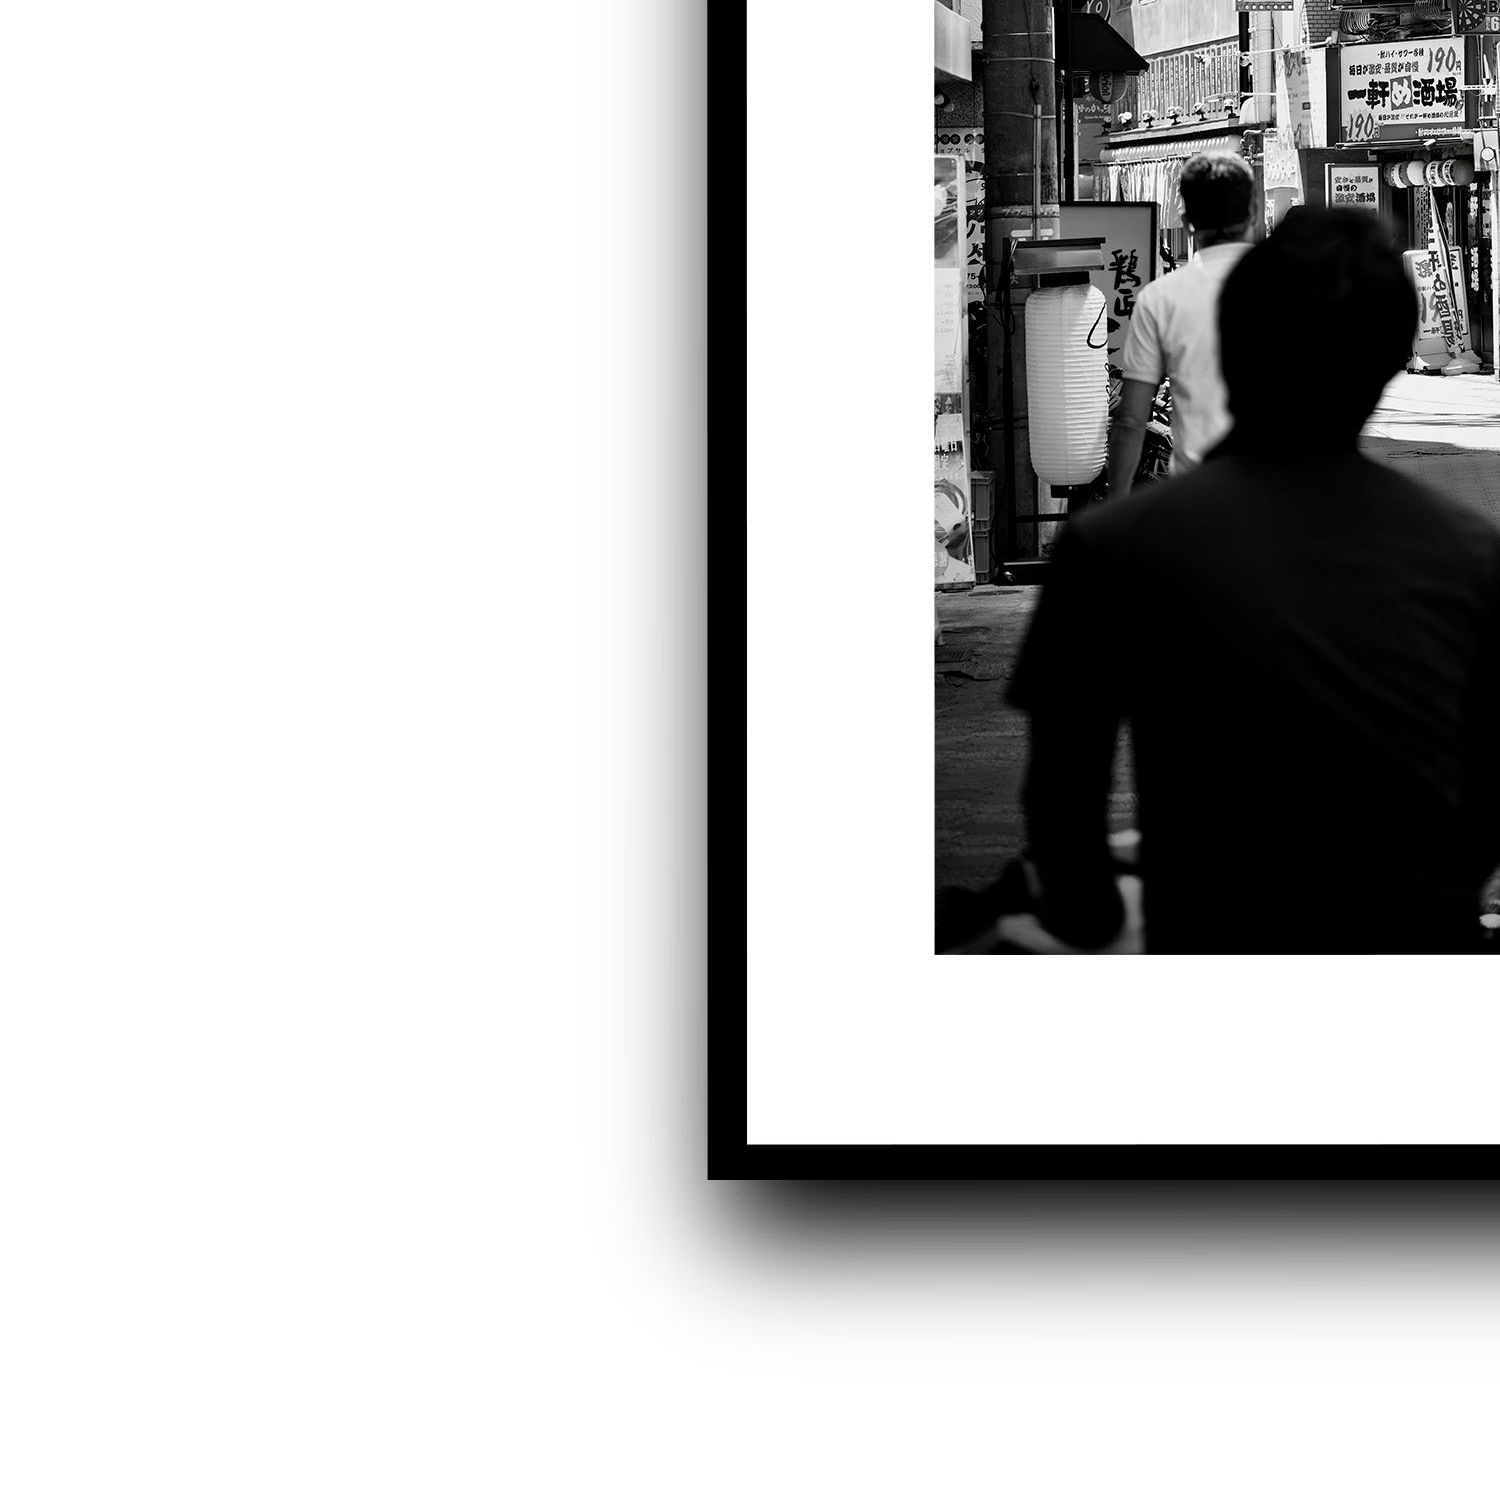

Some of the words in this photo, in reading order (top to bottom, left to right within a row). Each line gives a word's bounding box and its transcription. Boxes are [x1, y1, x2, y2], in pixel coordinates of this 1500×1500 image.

[1347, 75, 1459, 112] 一軒め酒場
